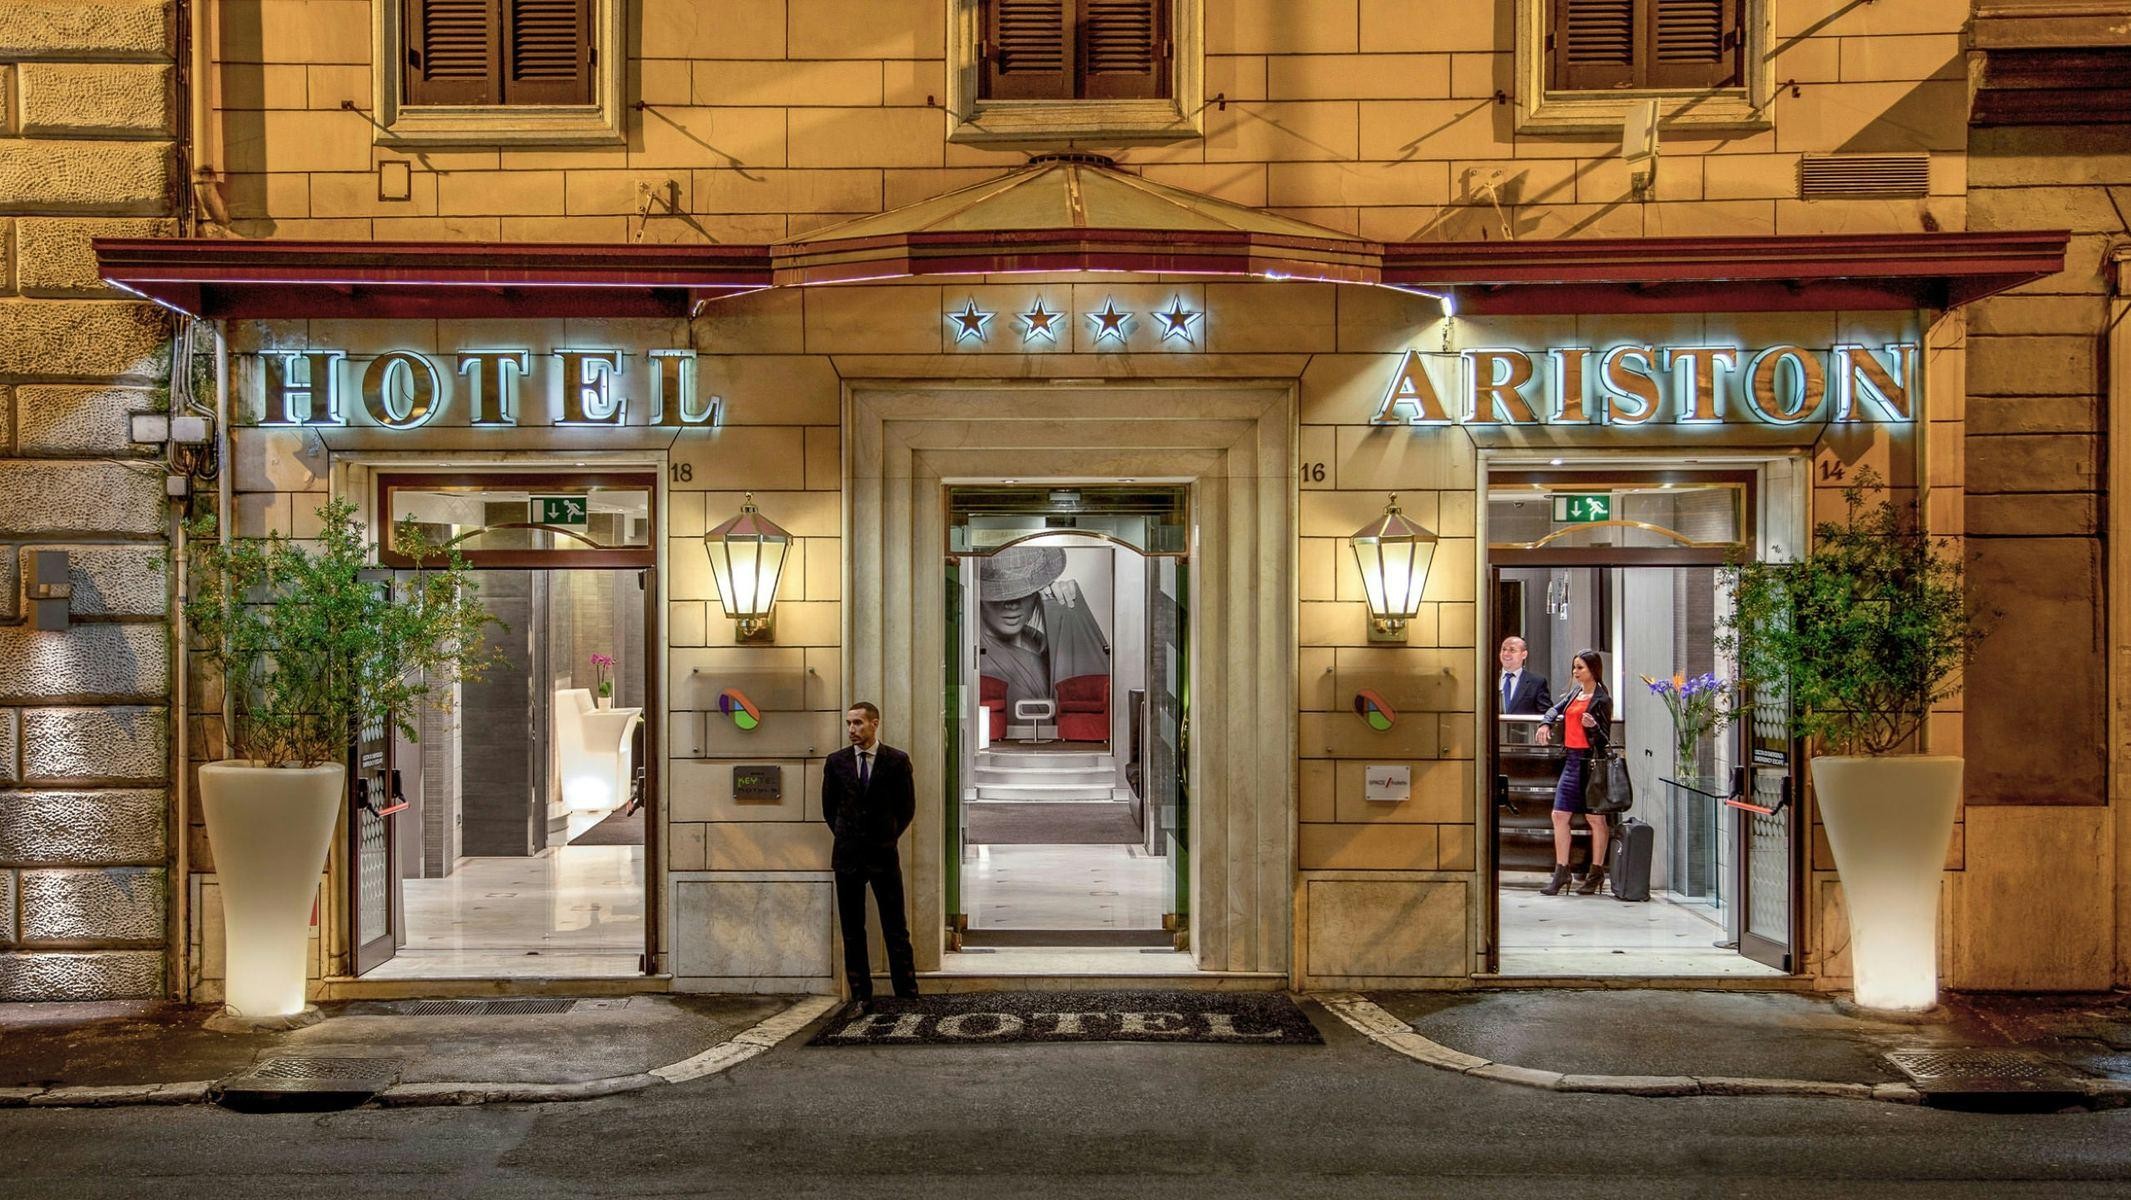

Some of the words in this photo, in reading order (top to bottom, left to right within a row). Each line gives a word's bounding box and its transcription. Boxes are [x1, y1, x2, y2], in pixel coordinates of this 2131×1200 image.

[257, 348, 721, 430] HOTEL
[1369, 343, 1919, 427] ARISTON
[671, 463, 693, 482] 18
[1301, 462, 1326, 482] 16
[1819, 460, 1845, 480] 14
[828, 1012, 1284, 1039] HOTEL
